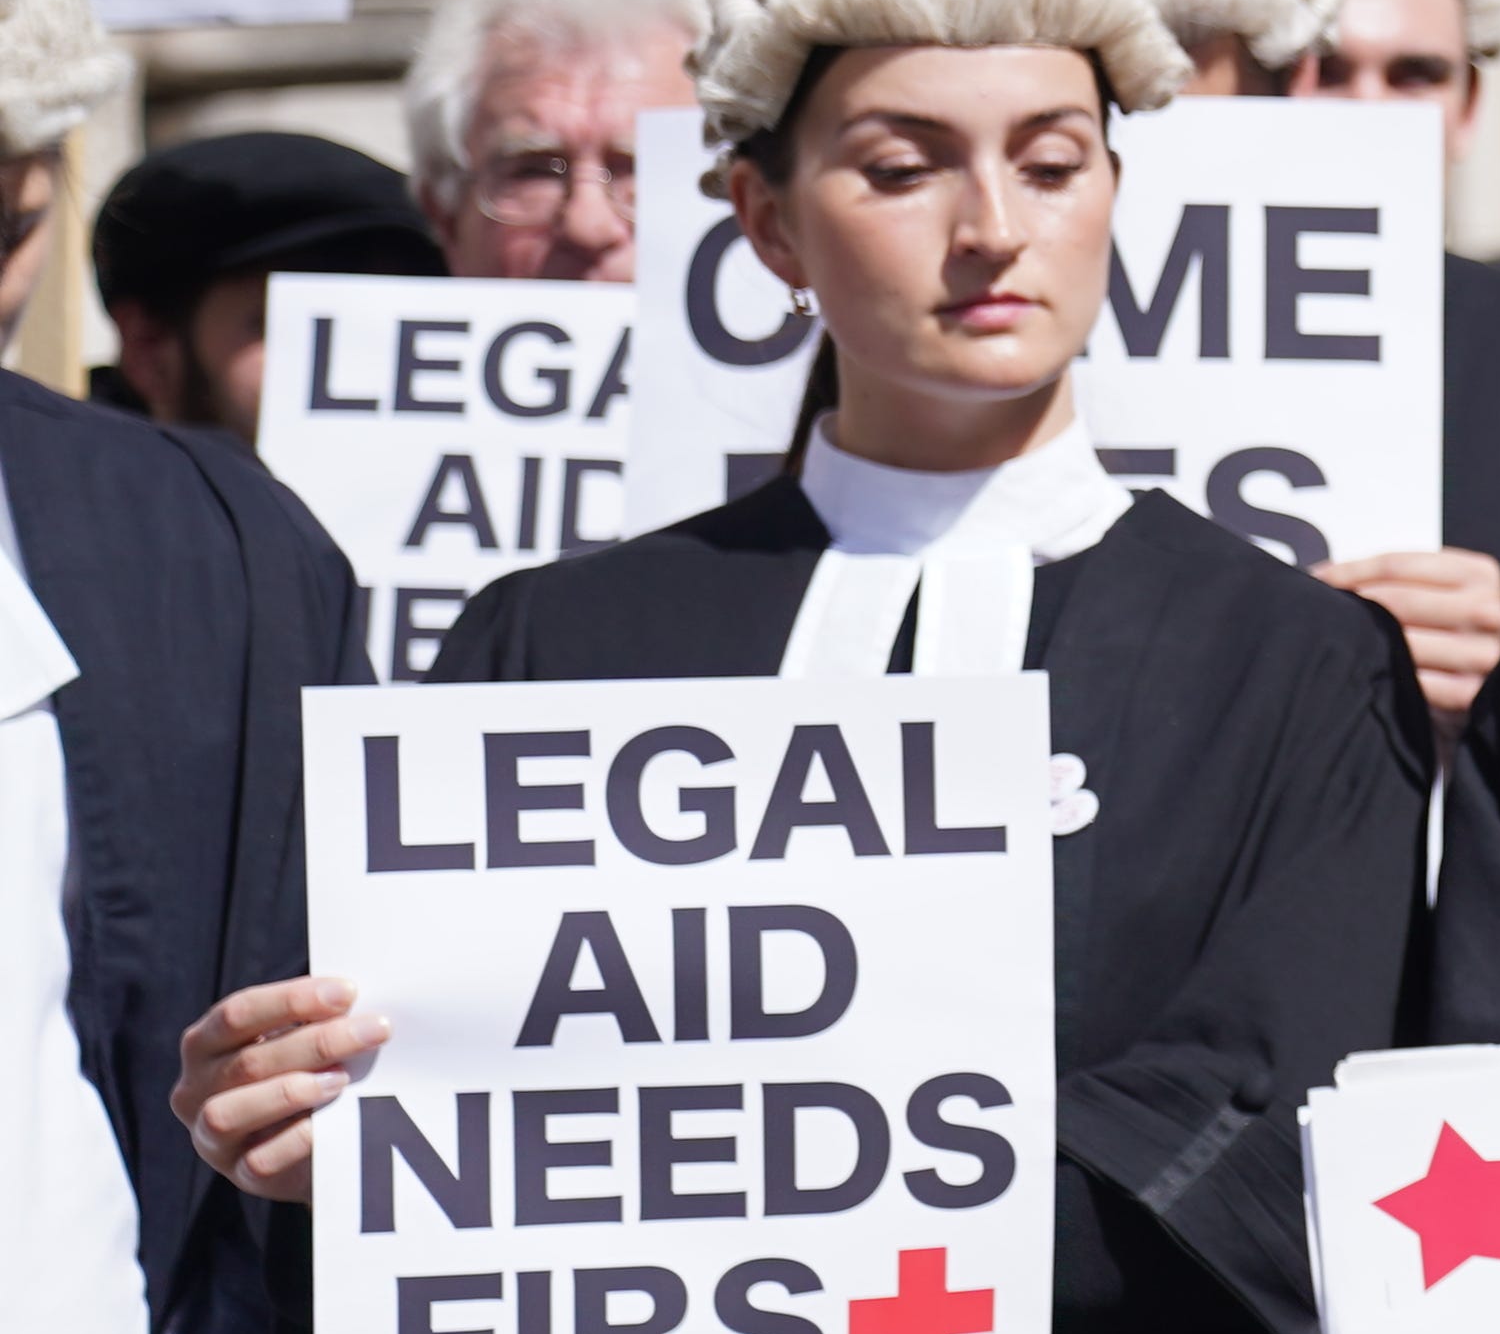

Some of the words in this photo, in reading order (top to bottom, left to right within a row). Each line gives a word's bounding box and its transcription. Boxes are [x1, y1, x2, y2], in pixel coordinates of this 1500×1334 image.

[685, 203, 1382, 366] CME
[362, 722, 1007, 873] LEGAL
[515, 904, 859, 1048] AID
[359, 1072, 1017, 1234] NEEDS
